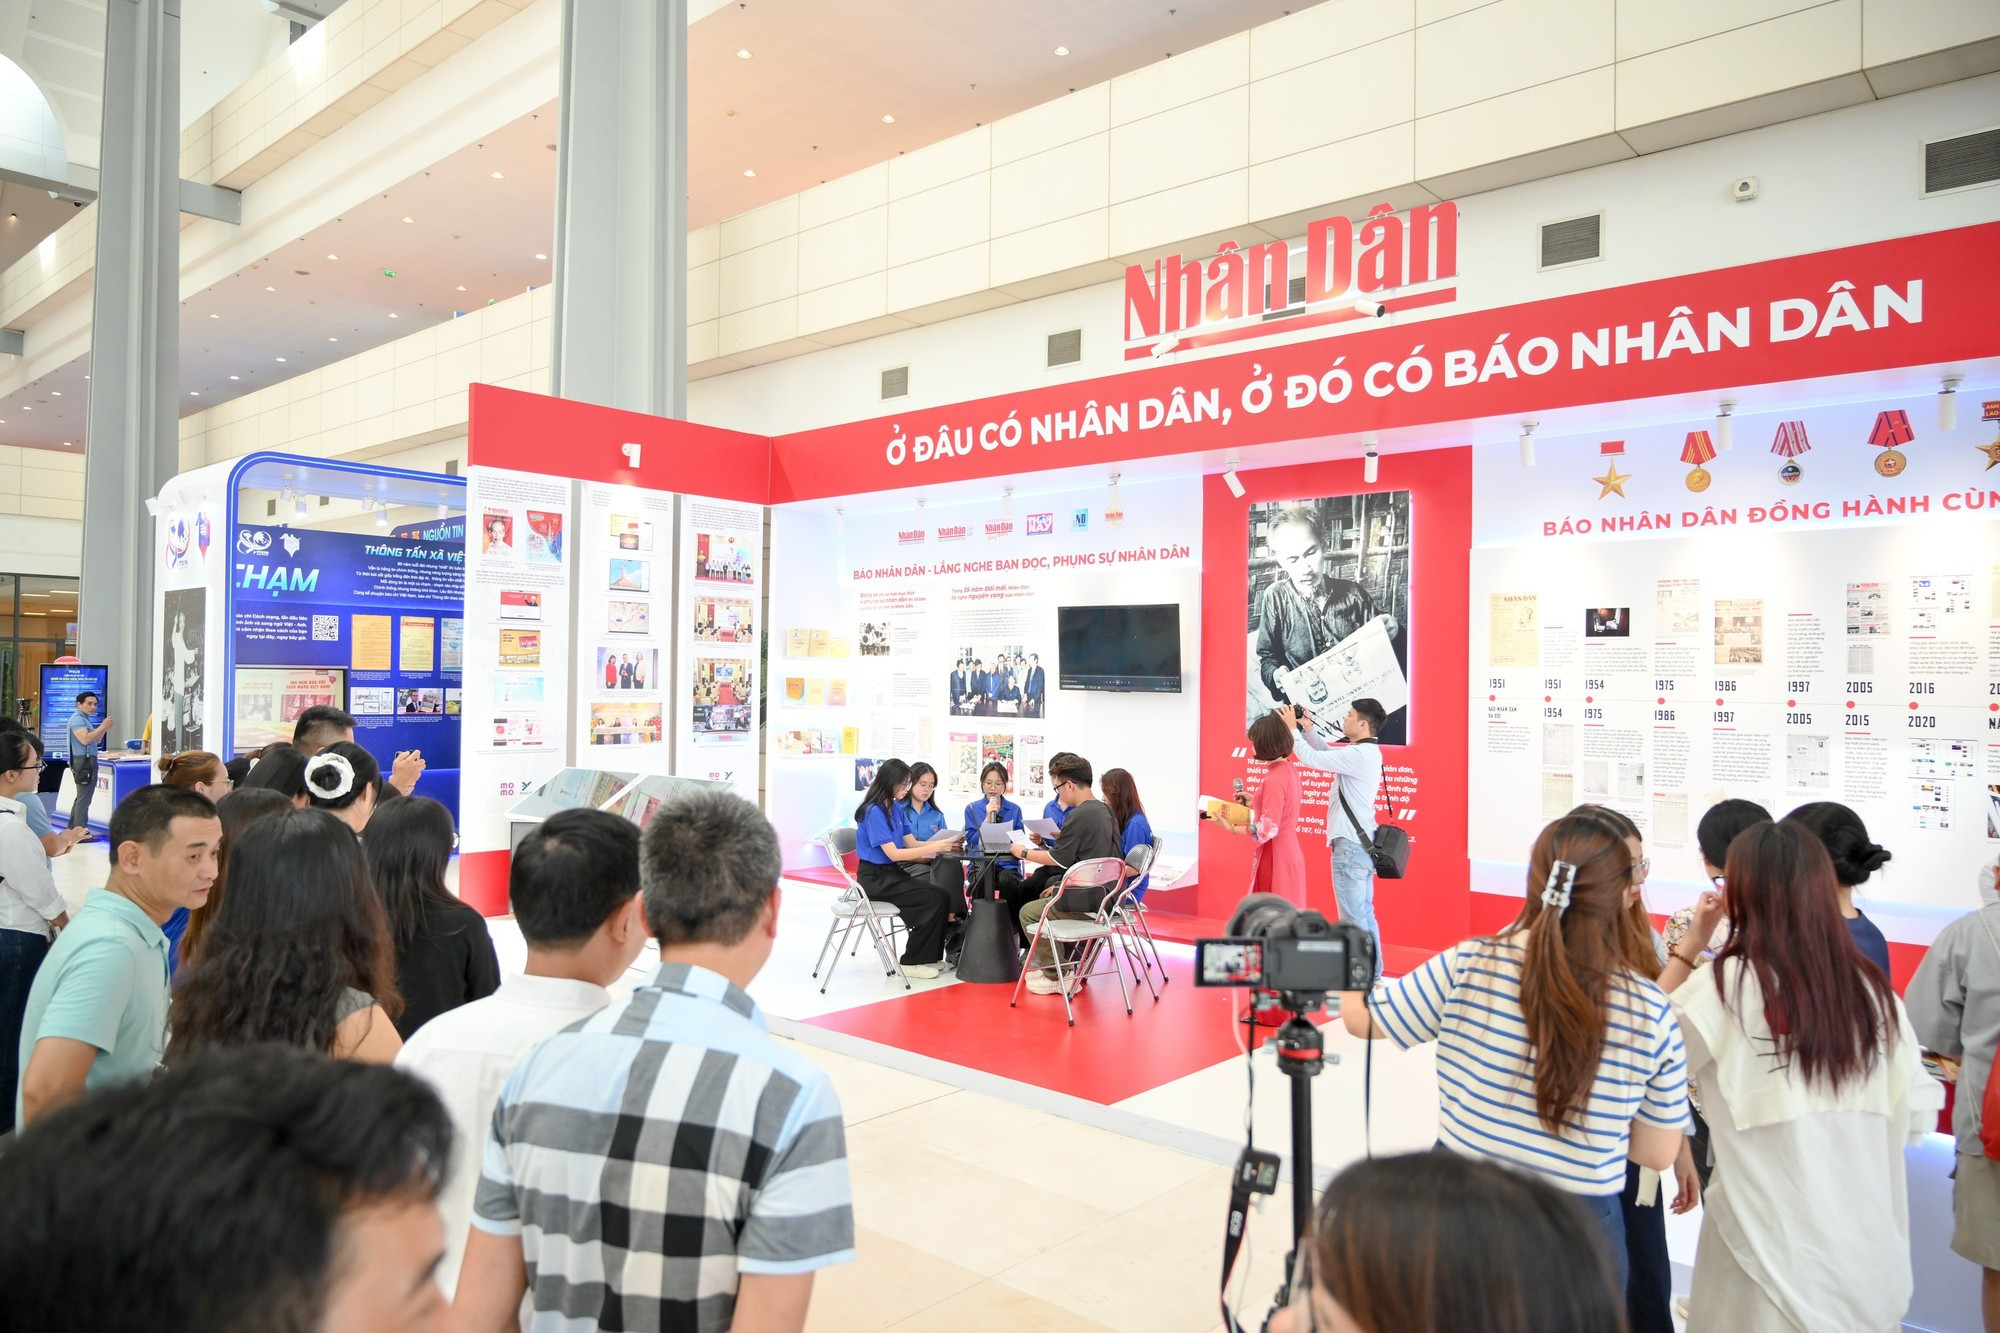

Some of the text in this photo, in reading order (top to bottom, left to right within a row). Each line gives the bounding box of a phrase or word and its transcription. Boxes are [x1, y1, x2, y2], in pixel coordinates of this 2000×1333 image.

[1124, 200, 1459, 342] Nhân Dân
[886, 279, 1924, 465] Ở ĐÂU CÓ NHÂN DÂN, Ở ĐÓ CÓ BÁO NHÂN DÂN
[1543, 516, 1592, 537] BÁO
[1601, 510, 1671, 532] NHÂN
[1682, 506, 1737, 527] DÂN
[1746, 499, 1830, 523] ĐỒNG
[1842, 494, 1929, 517] HÀNH
[423, 522, 464, 541] NGUỒN TIN
[938, 527, 953, 536] Nhân
[954, 526, 966, 535] Dân
[985, 522, 1013, 532] Nhân Dân
[898, 530, 925, 540] Nhân Dân
[364, 544, 403, 557] THÔNG
[406, 545, 427, 559] TẤN
[429, 549, 445, 560] XÃ
[853, 567, 873, 580] BÁO
[874, 565, 901, 579] NHÂN
[904, 563, 926, 577] DÂN
[933, 559, 961, 575] LẮNG
[964, 560, 993, 572] NGHE
[996, 559, 1019, 573] BẠN
[1022, 557, 1050, 571] ĐỌC,
[1053, 553, 1096, 568] PHỤNG
[1098, 549, 1116, 567] SỰ
[1118, 546, 1156, 563] NHÂN
[1160, 544, 1190, 560] DÂN
[1489, 678, 1506, 688] 1951
[1544, 678, 1562, 689] 1951
[1586, 679, 1605, 690] 1954
[1655, 680, 1674, 691] 1975
[1715, 680, 1737, 691] 1986
[1788, 681, 1810, 692] 1997
[1846, 681, 1873, 693] 2005
[1909, 682, 1935, 694] 2016
[1544, 707, 1562, 718] 1954
[1584, 708, 1603, 719] 1975
[1654, 710, 1675, 721] 1986
[1714, 711, 1735, 722] 1997
[1787, 713, 1812, 725] 2005
[1845, 714, 1869, 726] 2015
[1908, 716, 1936, 728] 2020
[1303, 770, 1321, 779] khắp.
[1394, 776, 1417, 784] những
[1303, 790, 1321, 798] ngày
[1402, 786, 1417, 794] đạo
[1305, 816, 1324, 826] Đảng
